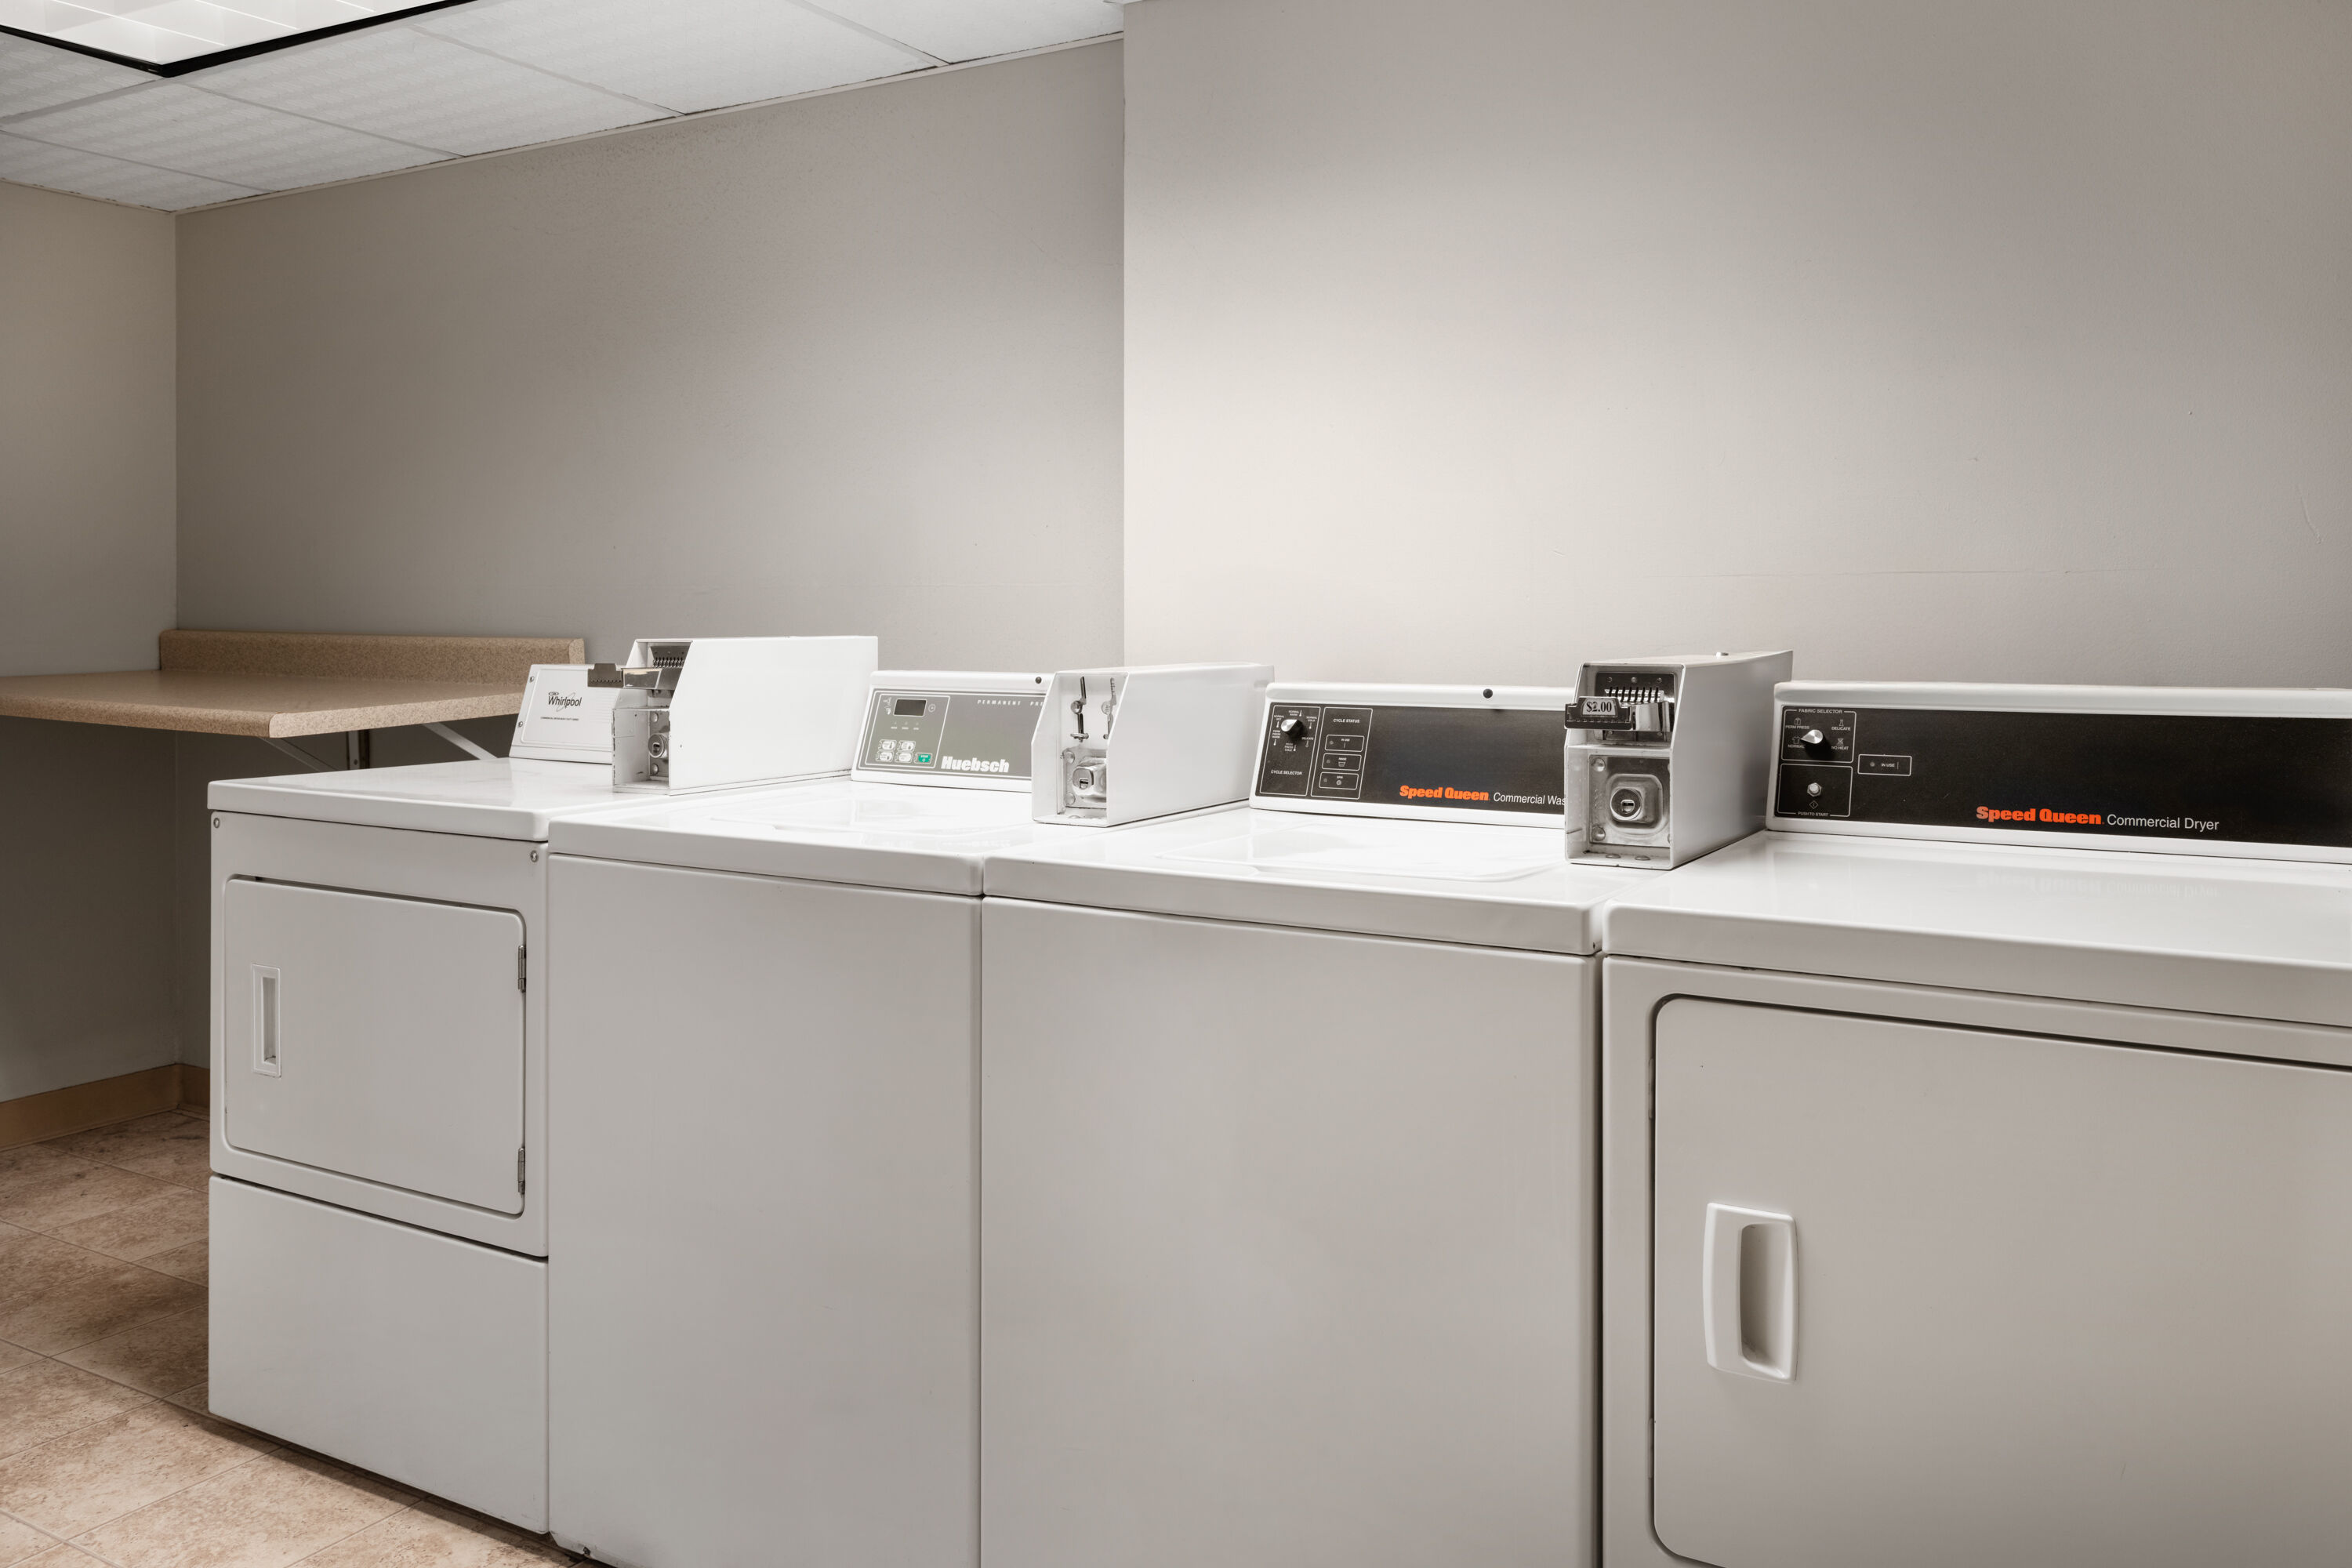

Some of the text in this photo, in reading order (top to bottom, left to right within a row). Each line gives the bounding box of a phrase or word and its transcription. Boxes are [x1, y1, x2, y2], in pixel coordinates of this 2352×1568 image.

[548, 695, 583, 709] Whirlpool
[1586, 701, 1612, 713] $2.00
[941, 756, 1010, 773] Huebsch
[1399, 785, 1443, 799] Speed
[1444, 787, 1490, 800] Queen
[1493, 792, 1545, 804] Commercial
[1976, 806, 2220, 833] Speed Queen Commercial Dryer
